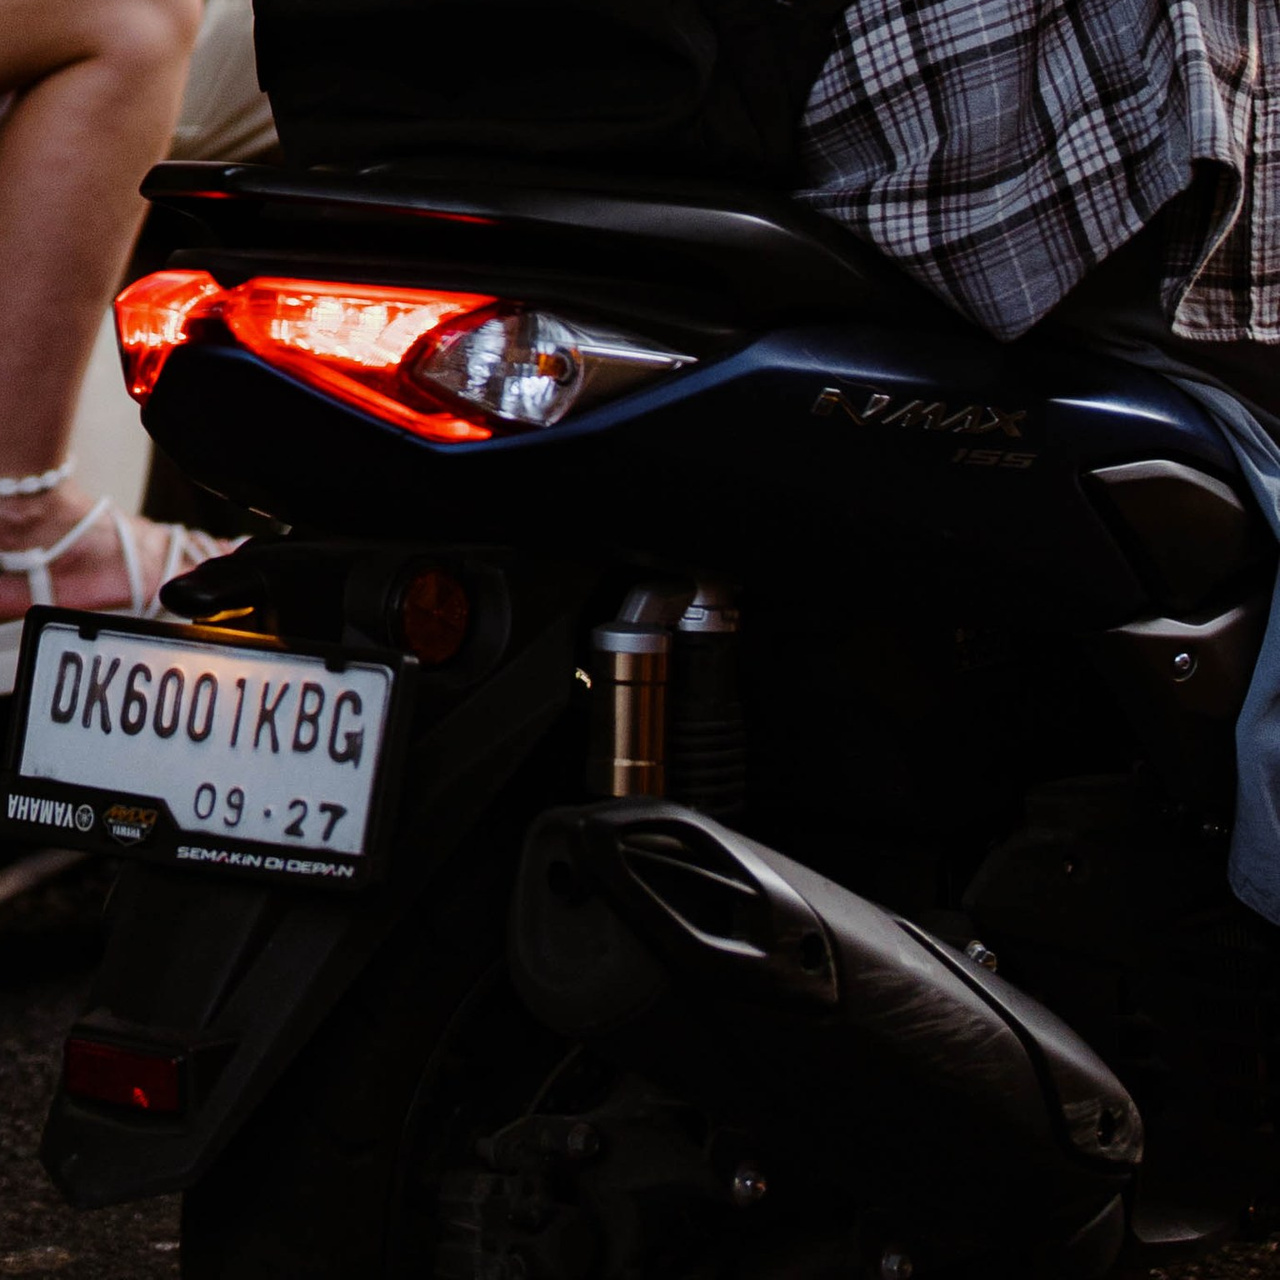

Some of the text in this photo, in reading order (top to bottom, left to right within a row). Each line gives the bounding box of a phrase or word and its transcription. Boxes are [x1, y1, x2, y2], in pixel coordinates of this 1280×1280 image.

[951, 448, 1038, 470] 155
[7, 793, 74, 829] YAMAHA
[176, 845, 262, 868] SEMAKIN
[286, 859, 355, 879] DEPAN
